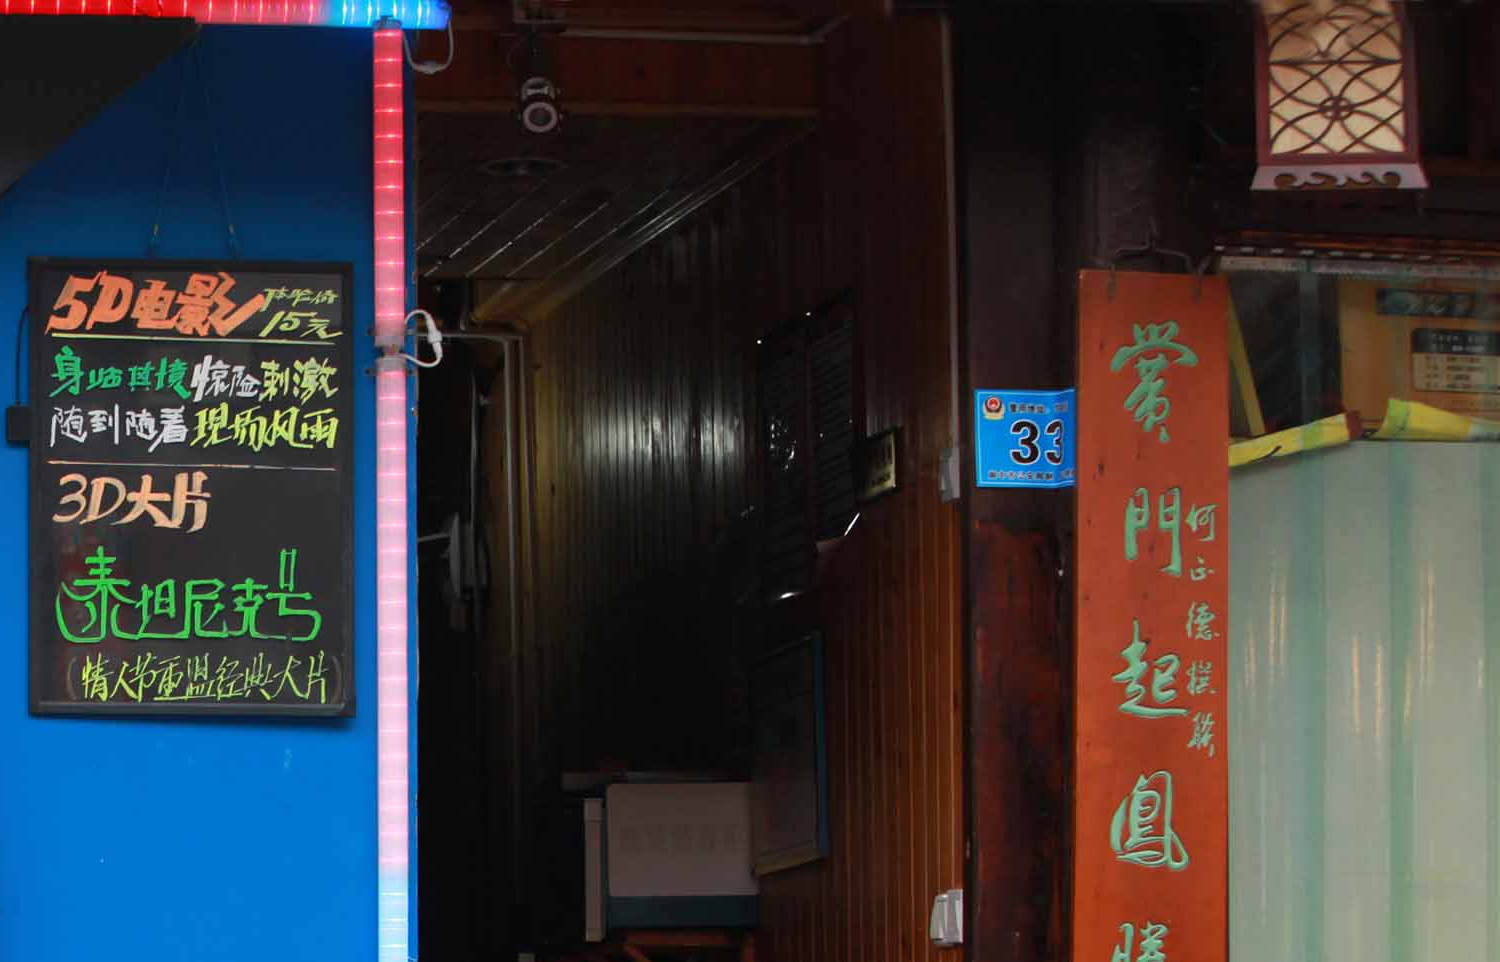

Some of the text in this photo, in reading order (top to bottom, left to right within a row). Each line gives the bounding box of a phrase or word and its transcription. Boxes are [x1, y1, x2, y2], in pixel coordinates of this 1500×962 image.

[45, 270, 264, 337] 5D电影
[258, 311, 343, 339] 15元
[1009, 419, 1064, 466] 33
[51, 470, 212, 533] 3D大片
[55, 545, 322, 644] 泰坦尼克号
